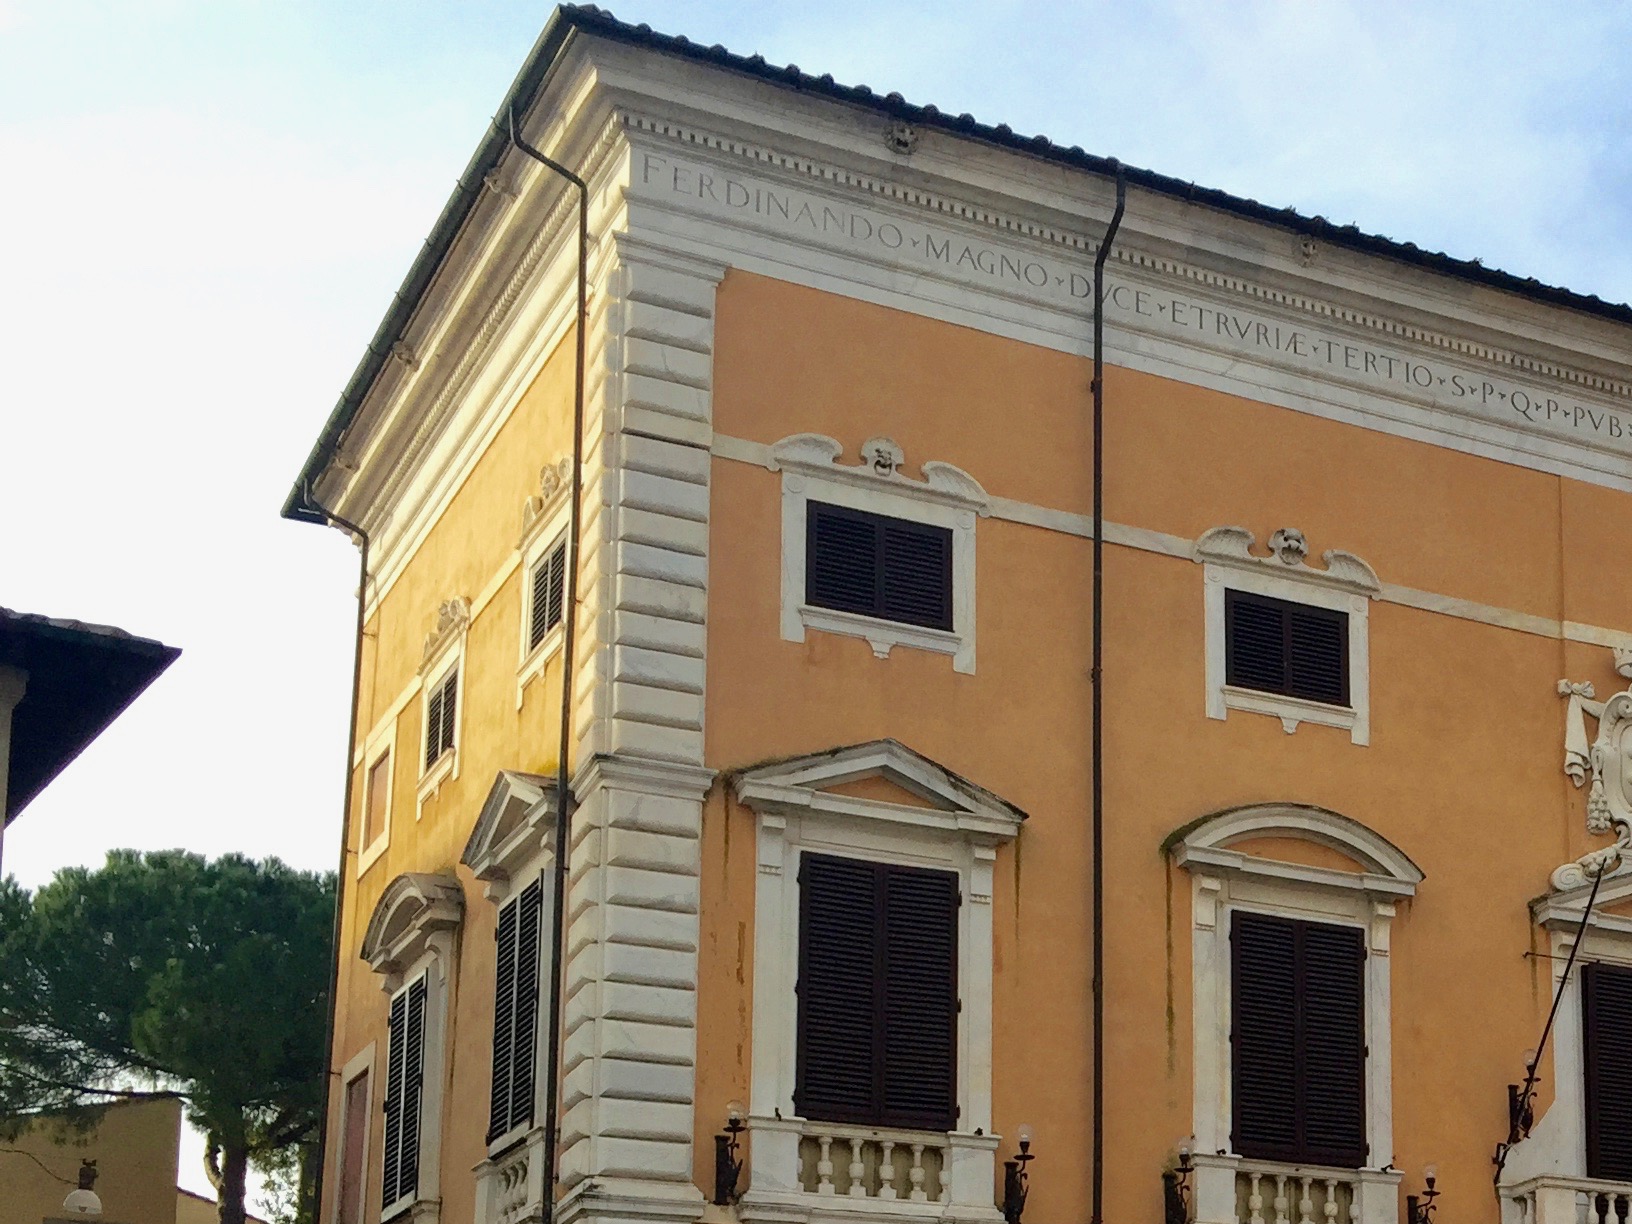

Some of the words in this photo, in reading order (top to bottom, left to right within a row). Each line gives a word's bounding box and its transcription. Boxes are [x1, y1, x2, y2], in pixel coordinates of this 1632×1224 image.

[643, 154, 903, 249] FERDINANDO
[925, 233, 1049, 288] MAGNO
[1318, 340, 1433, 388] TERTIO
